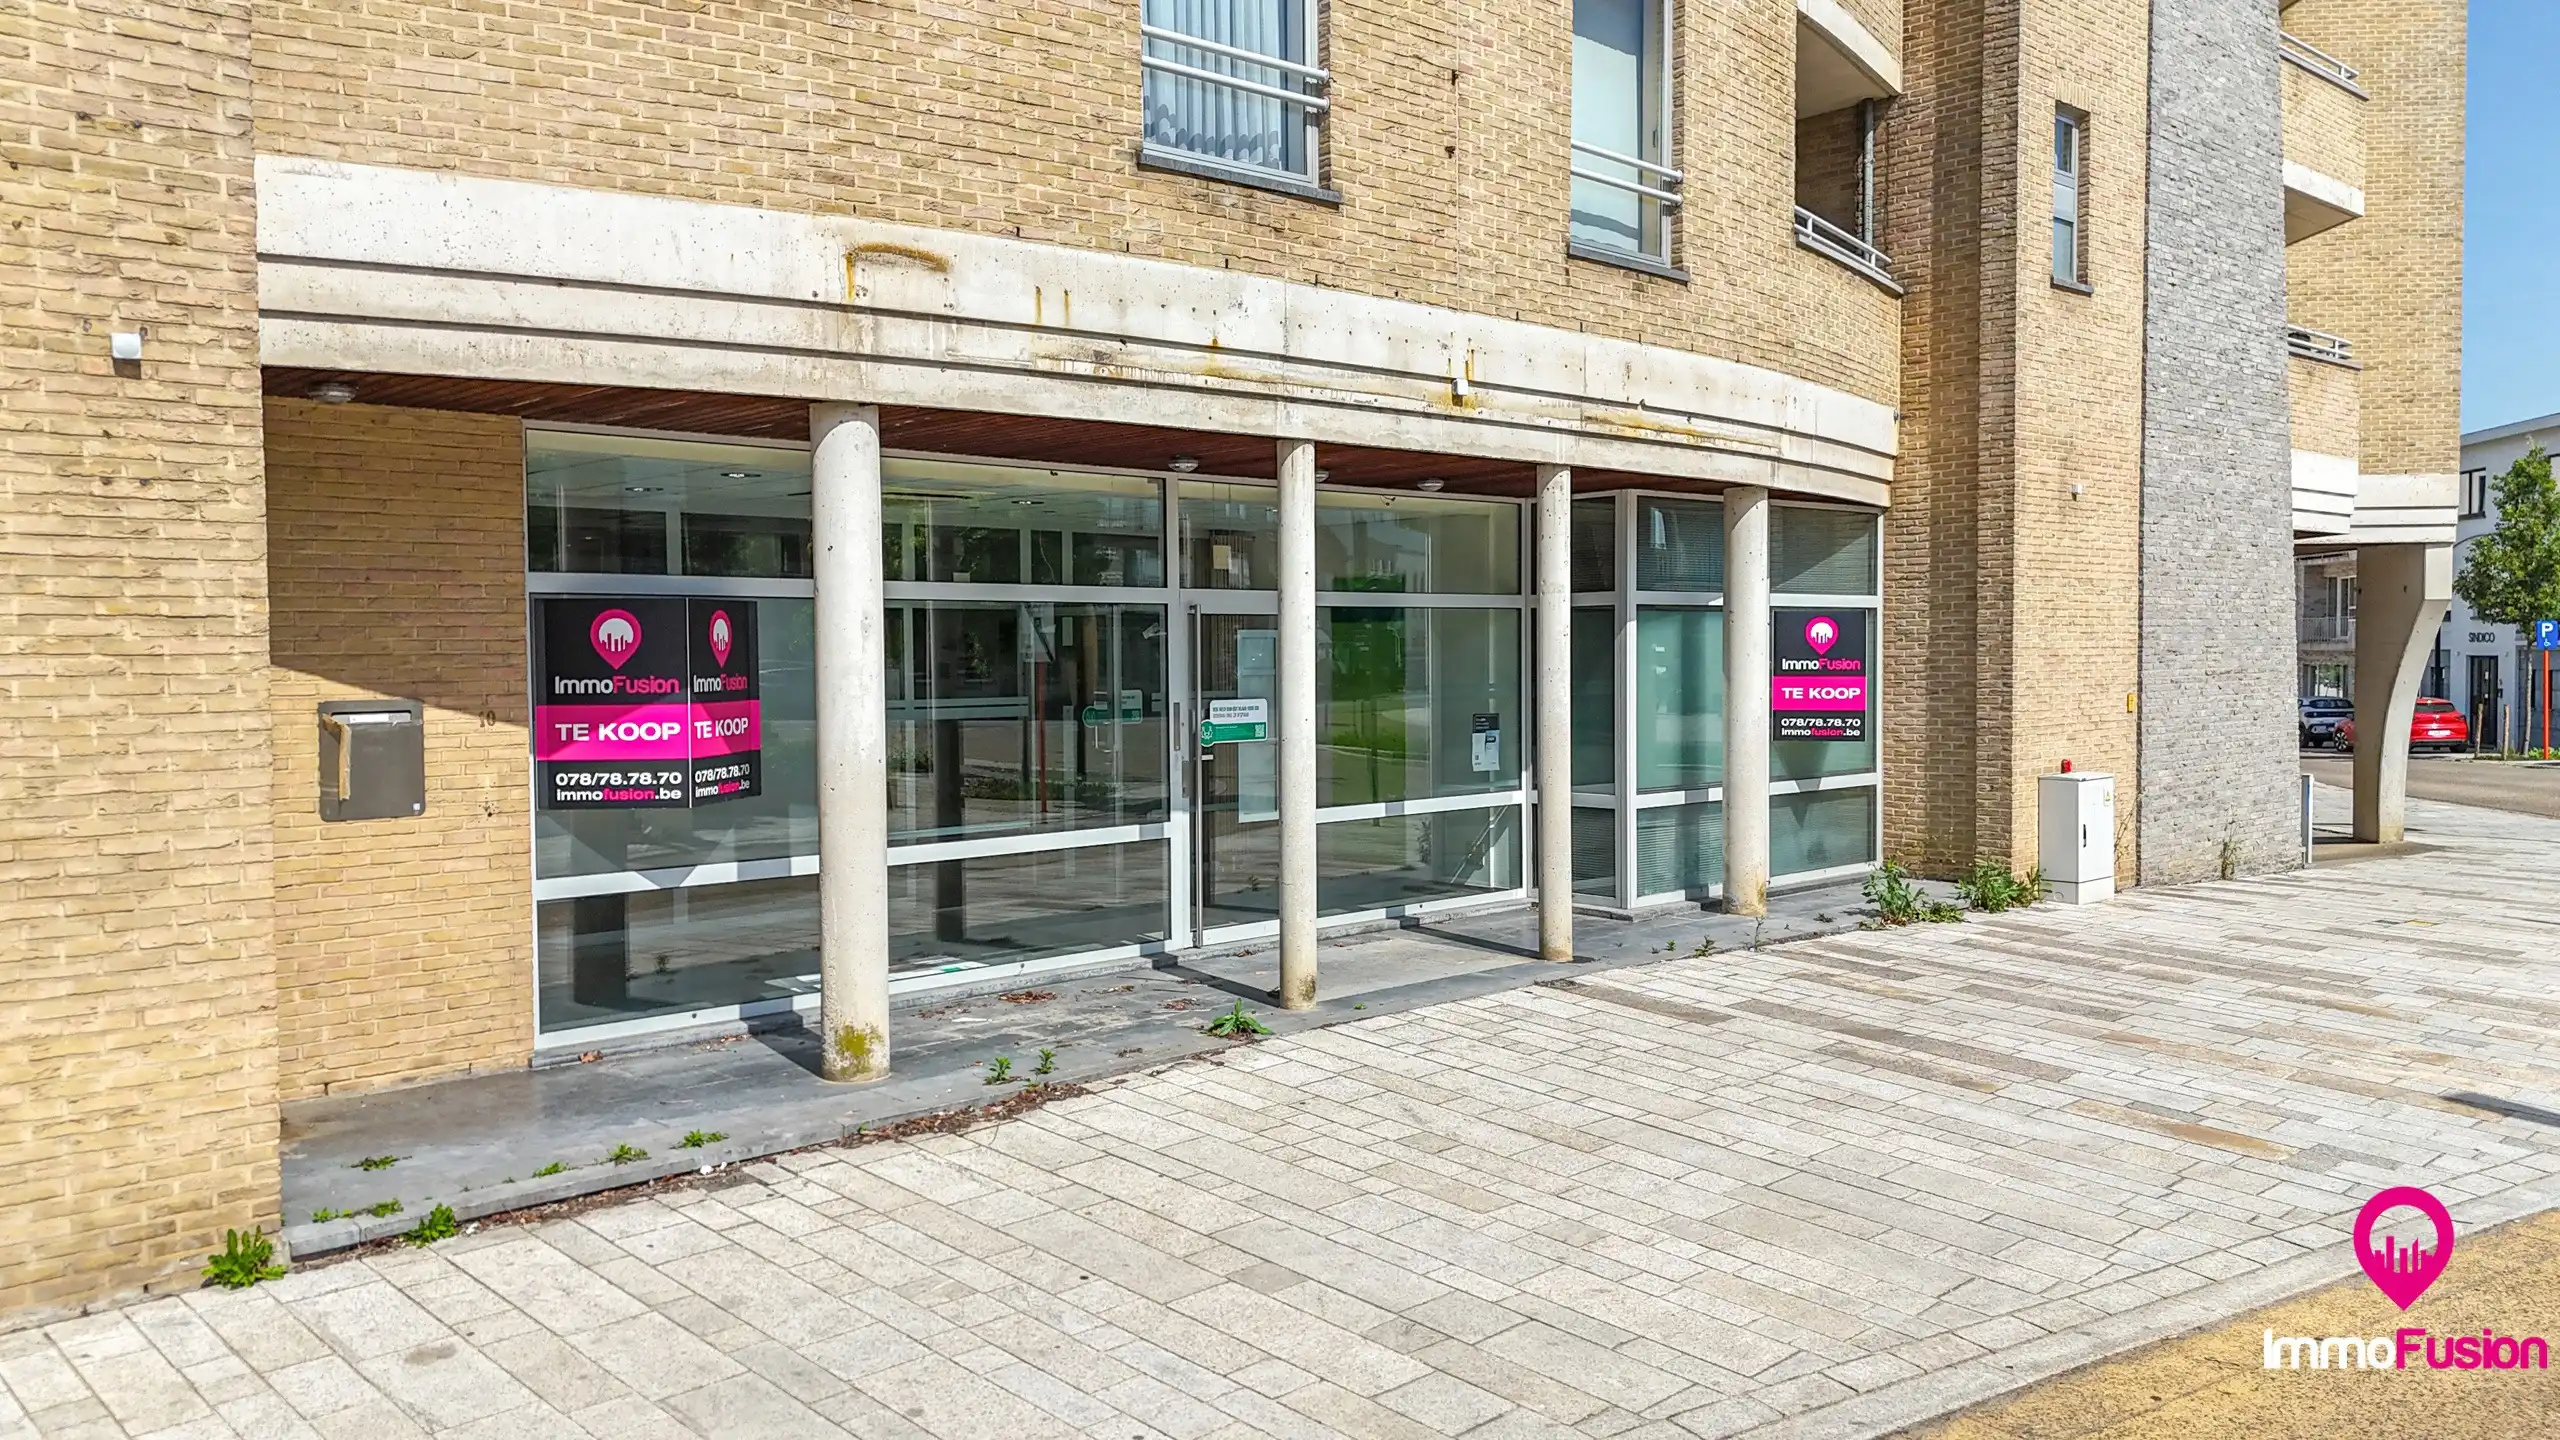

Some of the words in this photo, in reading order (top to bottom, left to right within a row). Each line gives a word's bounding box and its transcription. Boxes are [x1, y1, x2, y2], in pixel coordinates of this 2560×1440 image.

[2468, 632, 2495, 643] SINDICO
[2541, 622, 2553, 638] P
[1781, 658, 1861, 670] ImmoFusion
[555, 675, 680, 694] ImmoFusion
[693, 673, 748, 693] ImmoFusion
[1781, 687, 1804, 699] TE
[1808, 687, 1861, 699] KOOP
[478, 710, 496, 728] 10
[1781, 718, 1861, 727] 078/78.78.70
[555, 723, 590, 741] TE
[598, 722, 681, 741] KOOP
[694, 720, 712, 740] TE
[715, 717, 749, 737] KOOP
[555, 772, 682, 786] 078/78.78.70
[694, 763, 750, 784] 078/78.78.70
[556, 788, 682, 801] immofusion.be
[695, 779, 750, 798] immofusion.be
